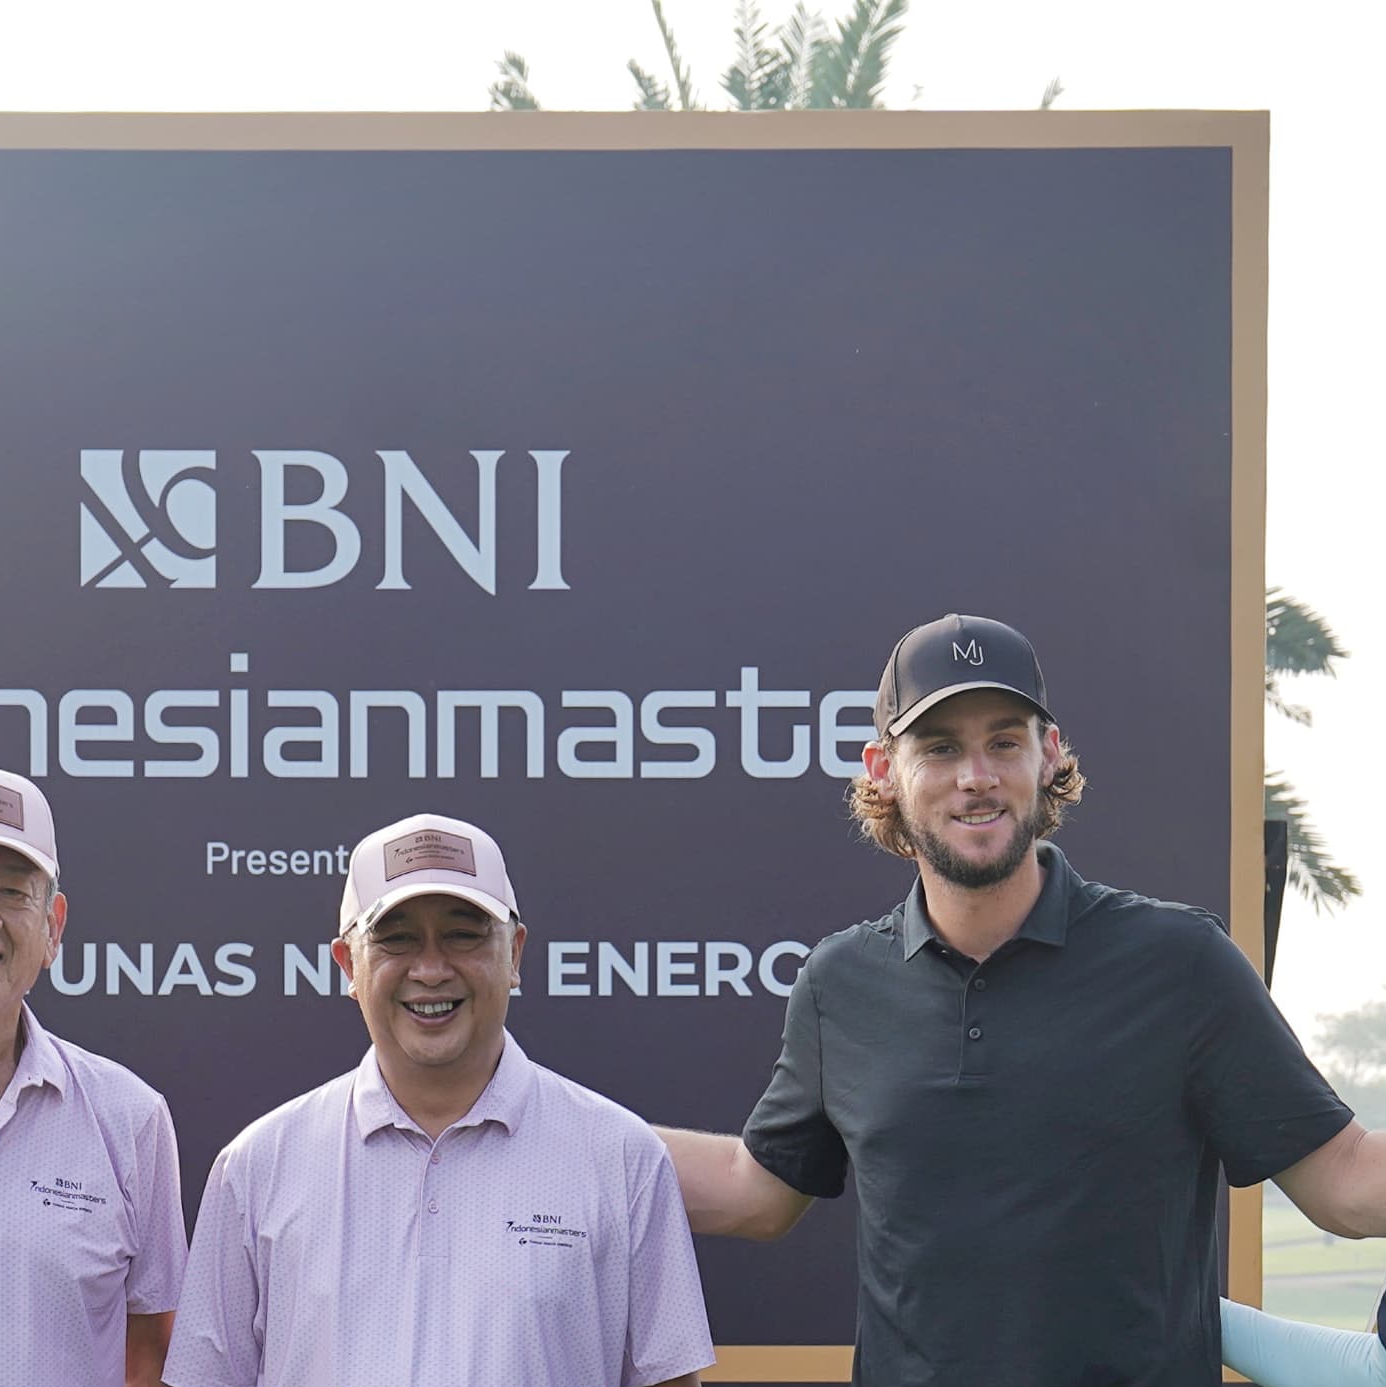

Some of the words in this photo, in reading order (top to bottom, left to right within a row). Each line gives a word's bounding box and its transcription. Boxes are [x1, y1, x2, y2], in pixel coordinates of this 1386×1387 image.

[251, 449, 571, 596] BNI
[952, 639, 984, 666] MJ
[206, 841, 350, 875] Present
[49, 942, 257, 997] UNAS
[548, 940, 812, 998] ENERG
